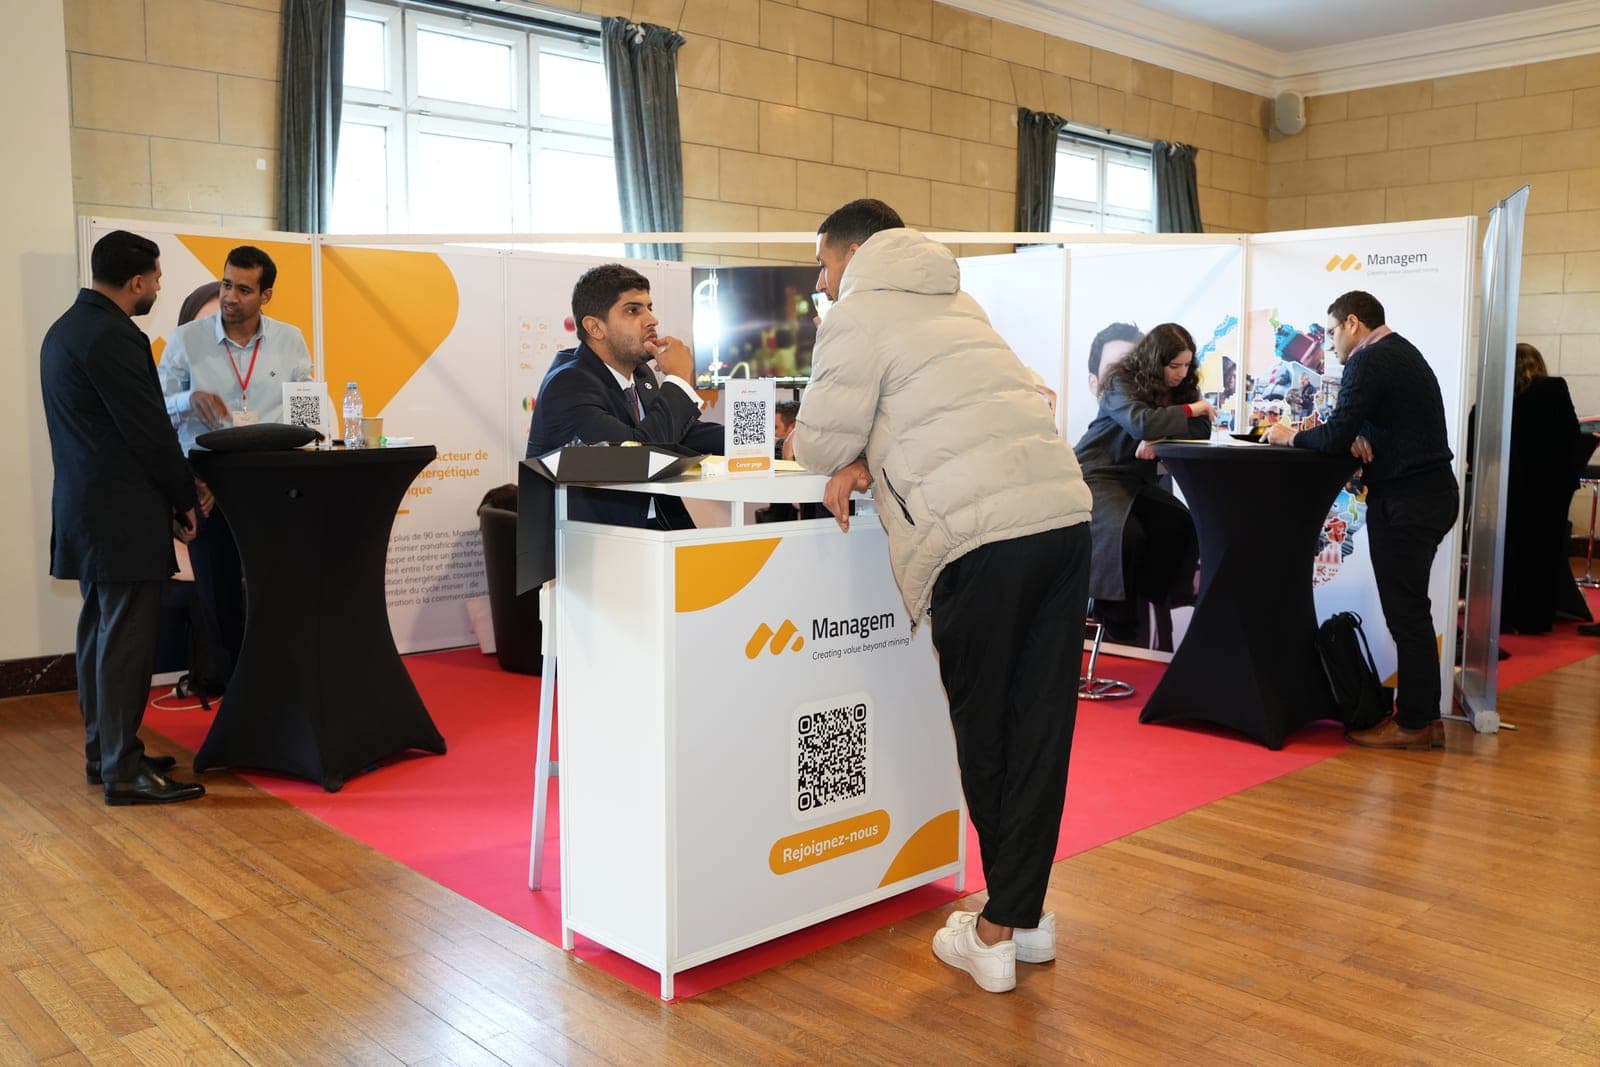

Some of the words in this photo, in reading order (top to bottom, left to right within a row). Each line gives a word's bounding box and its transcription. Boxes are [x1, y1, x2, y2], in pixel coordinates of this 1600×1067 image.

[1367, 253, 1427, 267] Managem
[475, 450, 488, 460] de
[418, 466, 480, 480] nergétique
[407, 486, 432, 497] ique
[812, 612, 895, 640] Managem
[812, 647, 843, 661] Creating
[843, 645, 862, 656] value
[862, 640, 887, 653] beyond
[887, 636, 910, 650] mining
[783, 825, 879, 863] Rejoignez-nous
